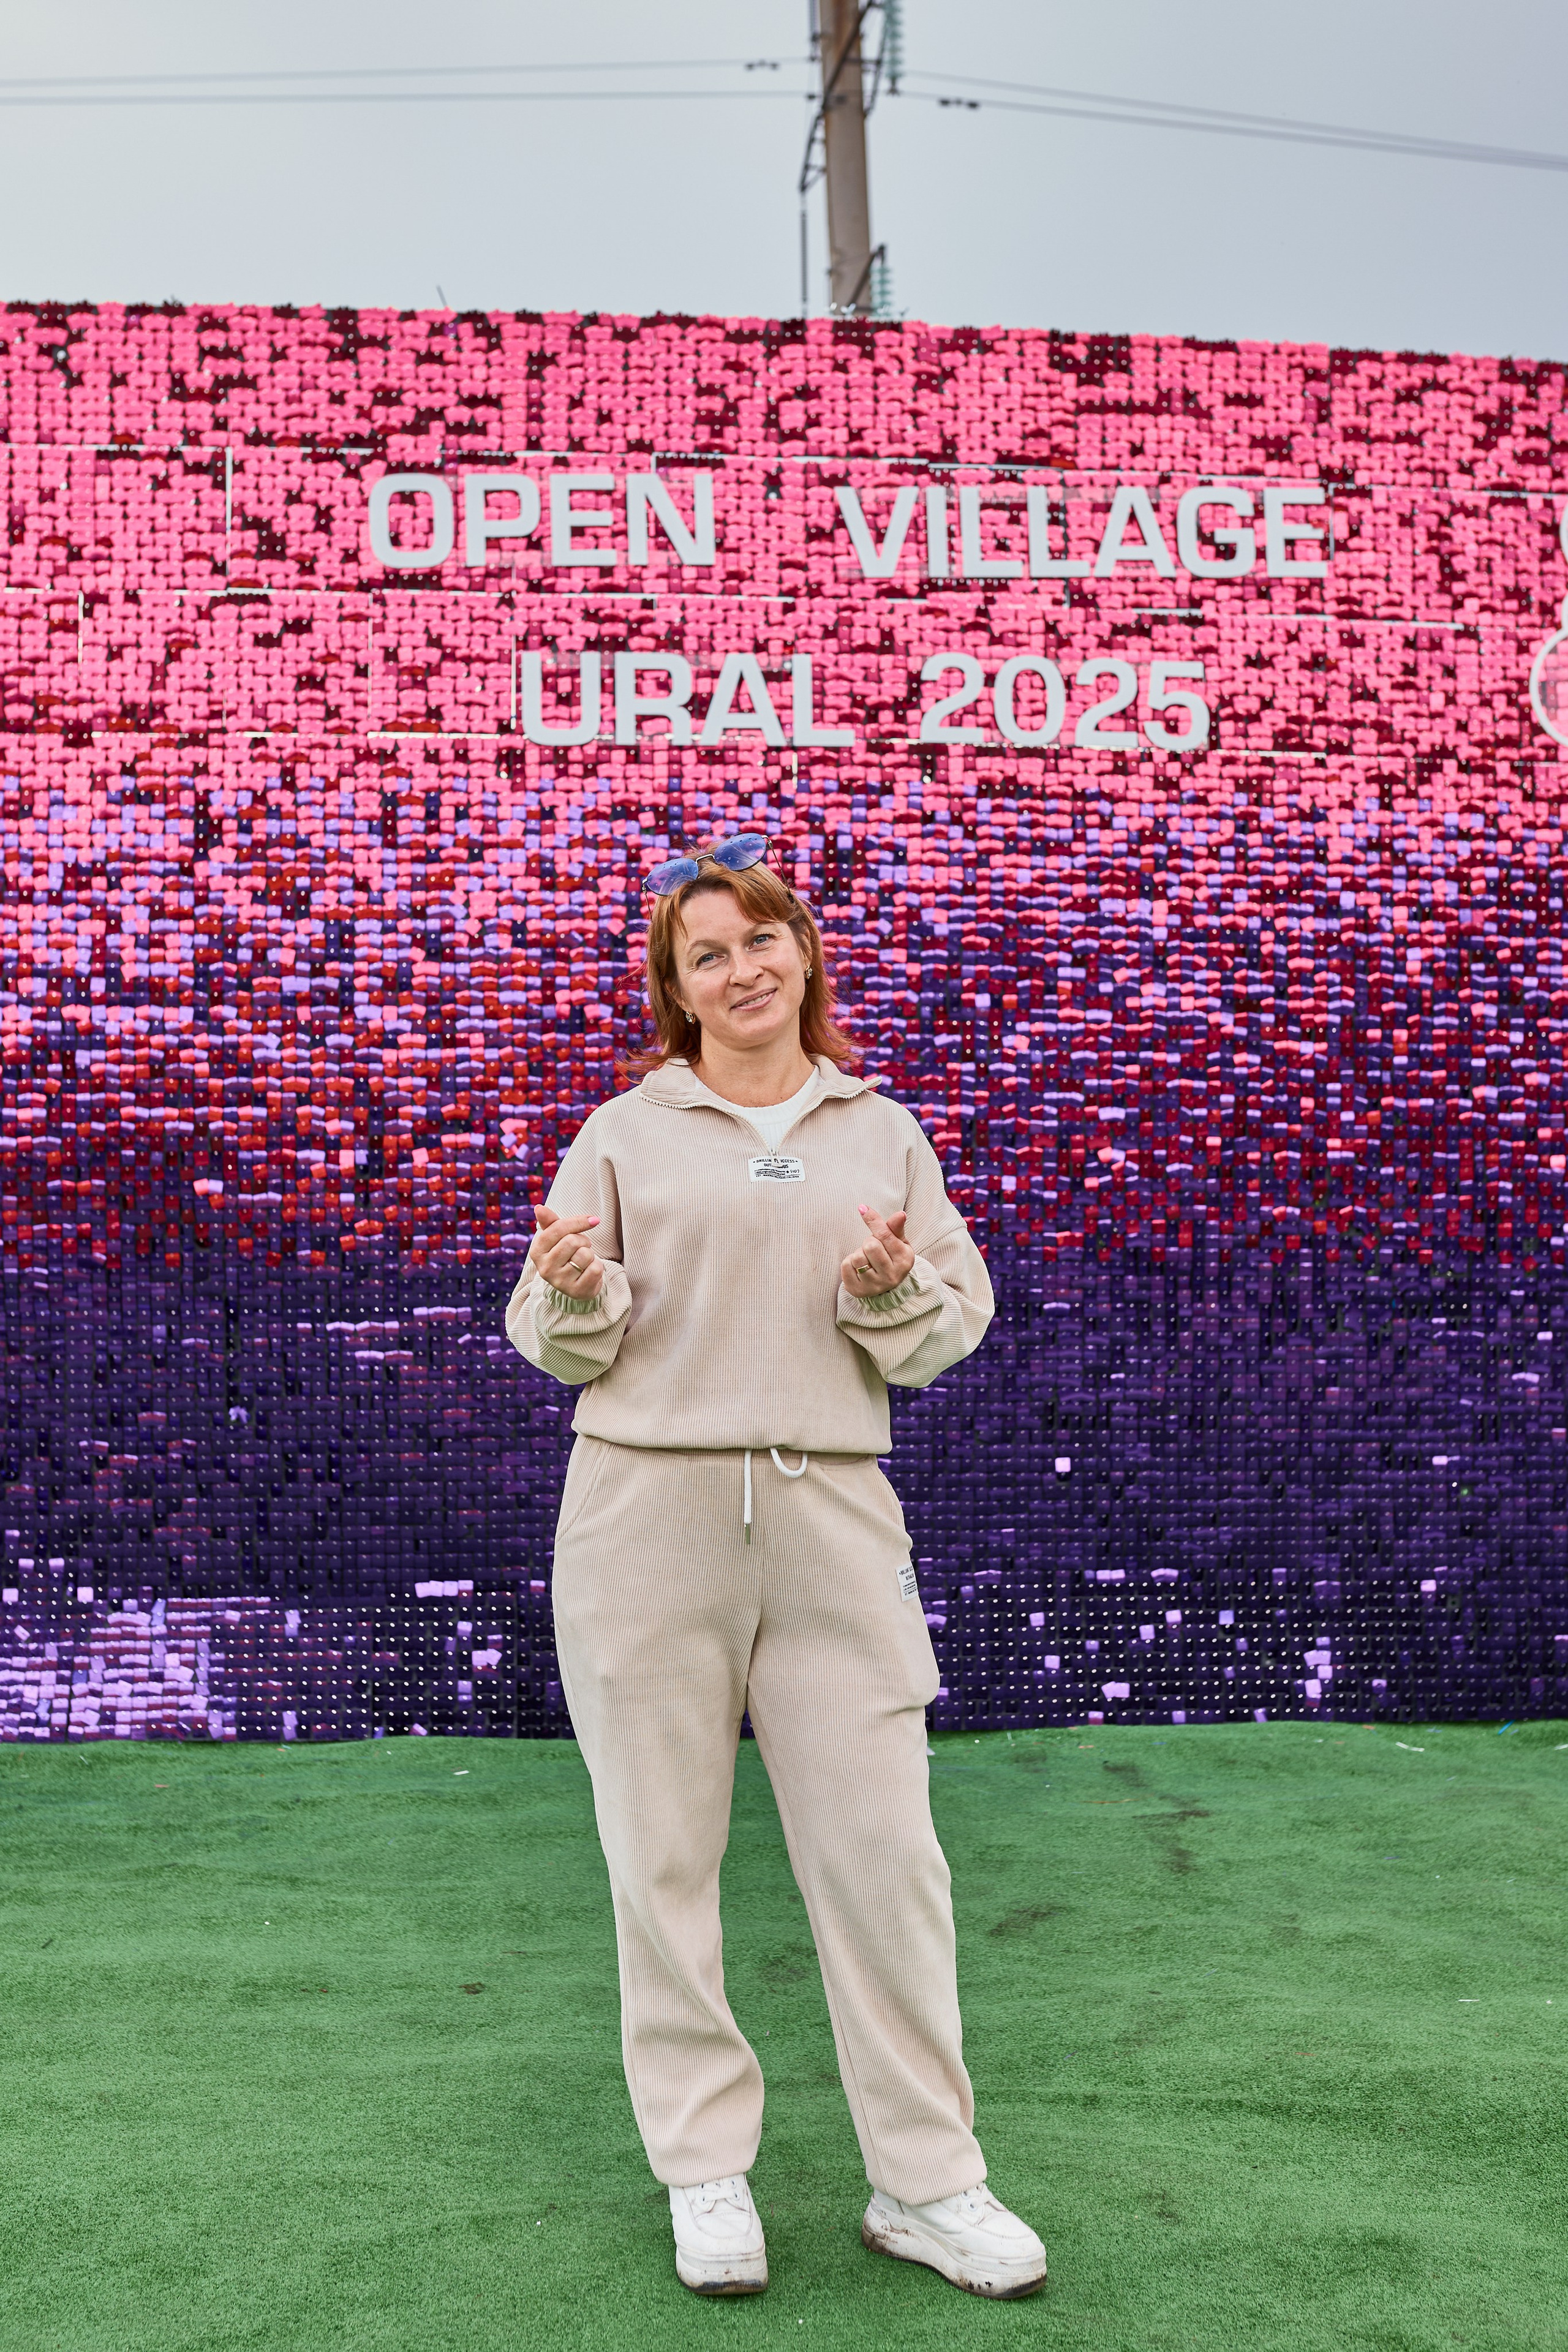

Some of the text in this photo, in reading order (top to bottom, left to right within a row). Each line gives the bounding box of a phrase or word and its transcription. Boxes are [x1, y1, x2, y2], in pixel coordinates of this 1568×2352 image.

[368, 472, 1329, 579] OPEN VILLAGE
[521, 650, 1211, 753] URAL 2025
